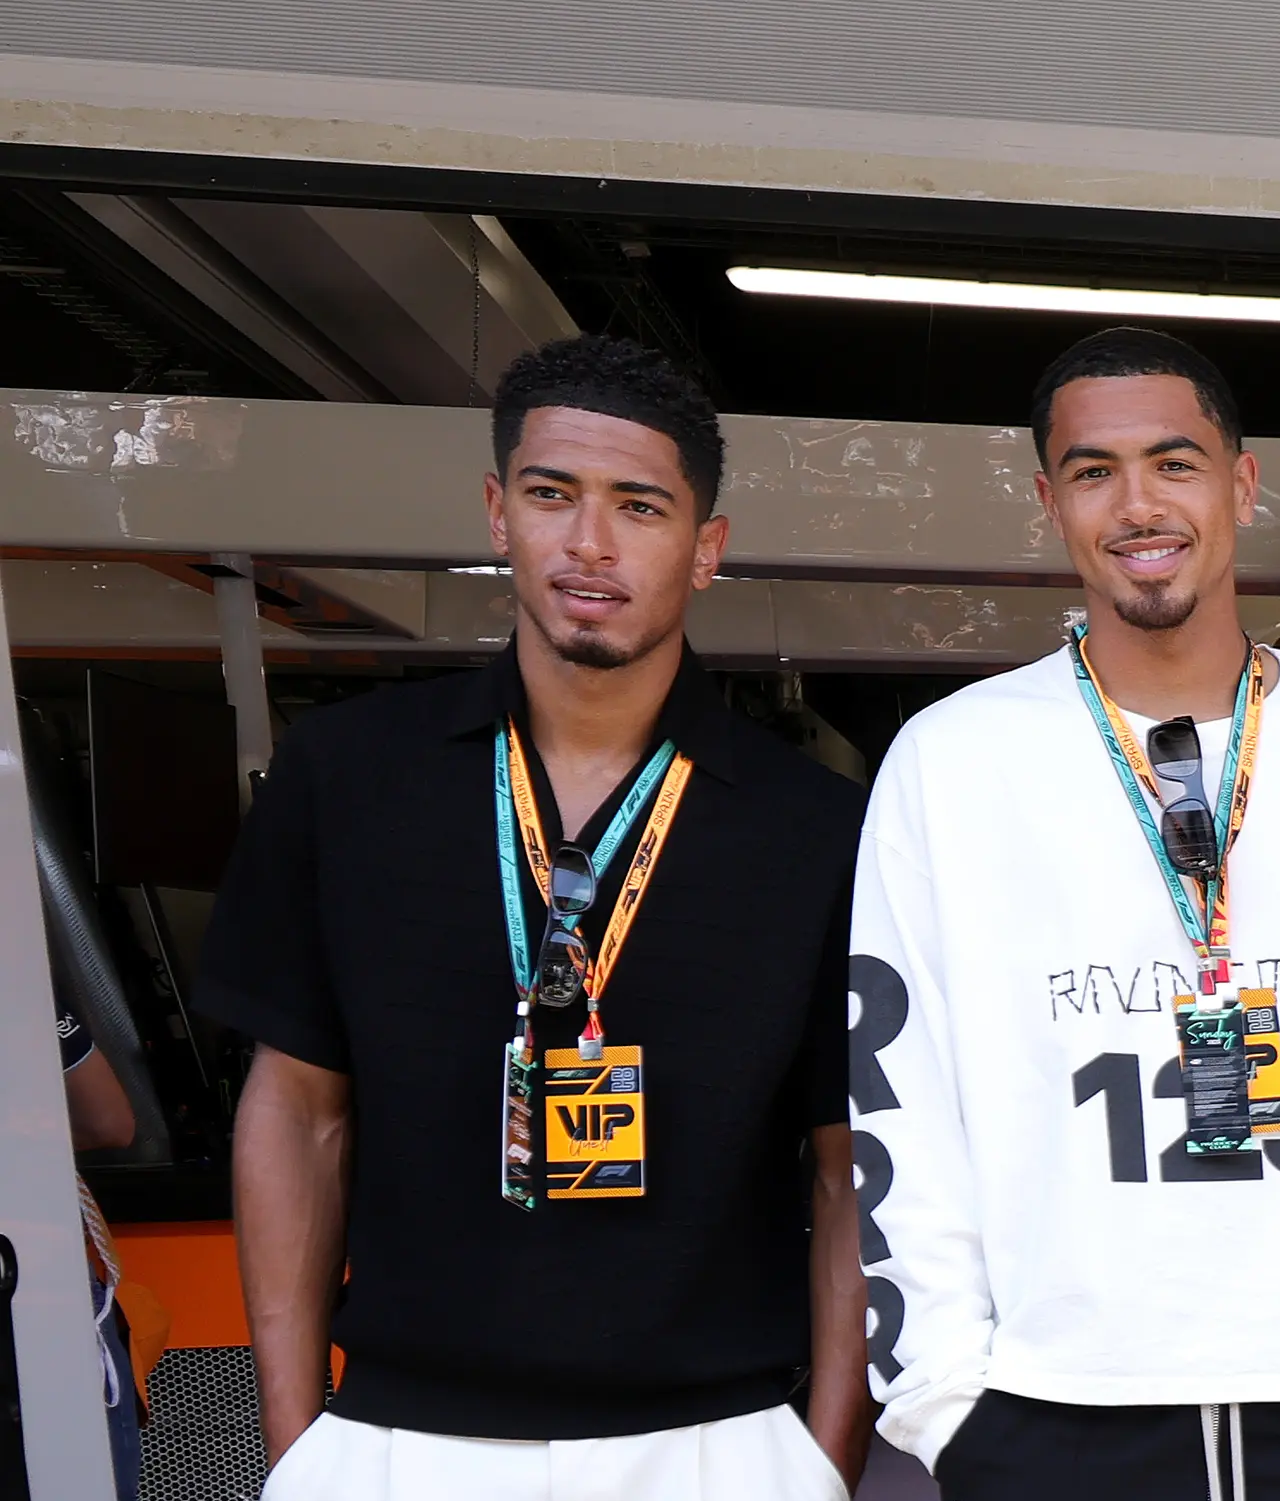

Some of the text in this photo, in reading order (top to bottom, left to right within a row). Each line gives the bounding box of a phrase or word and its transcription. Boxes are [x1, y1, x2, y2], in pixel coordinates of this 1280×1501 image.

[653, 789, 676, 827] SPAIN
[1186, 1019, 1238, 1051] Sunday
[555, 1103, 634, 1141] VIP
